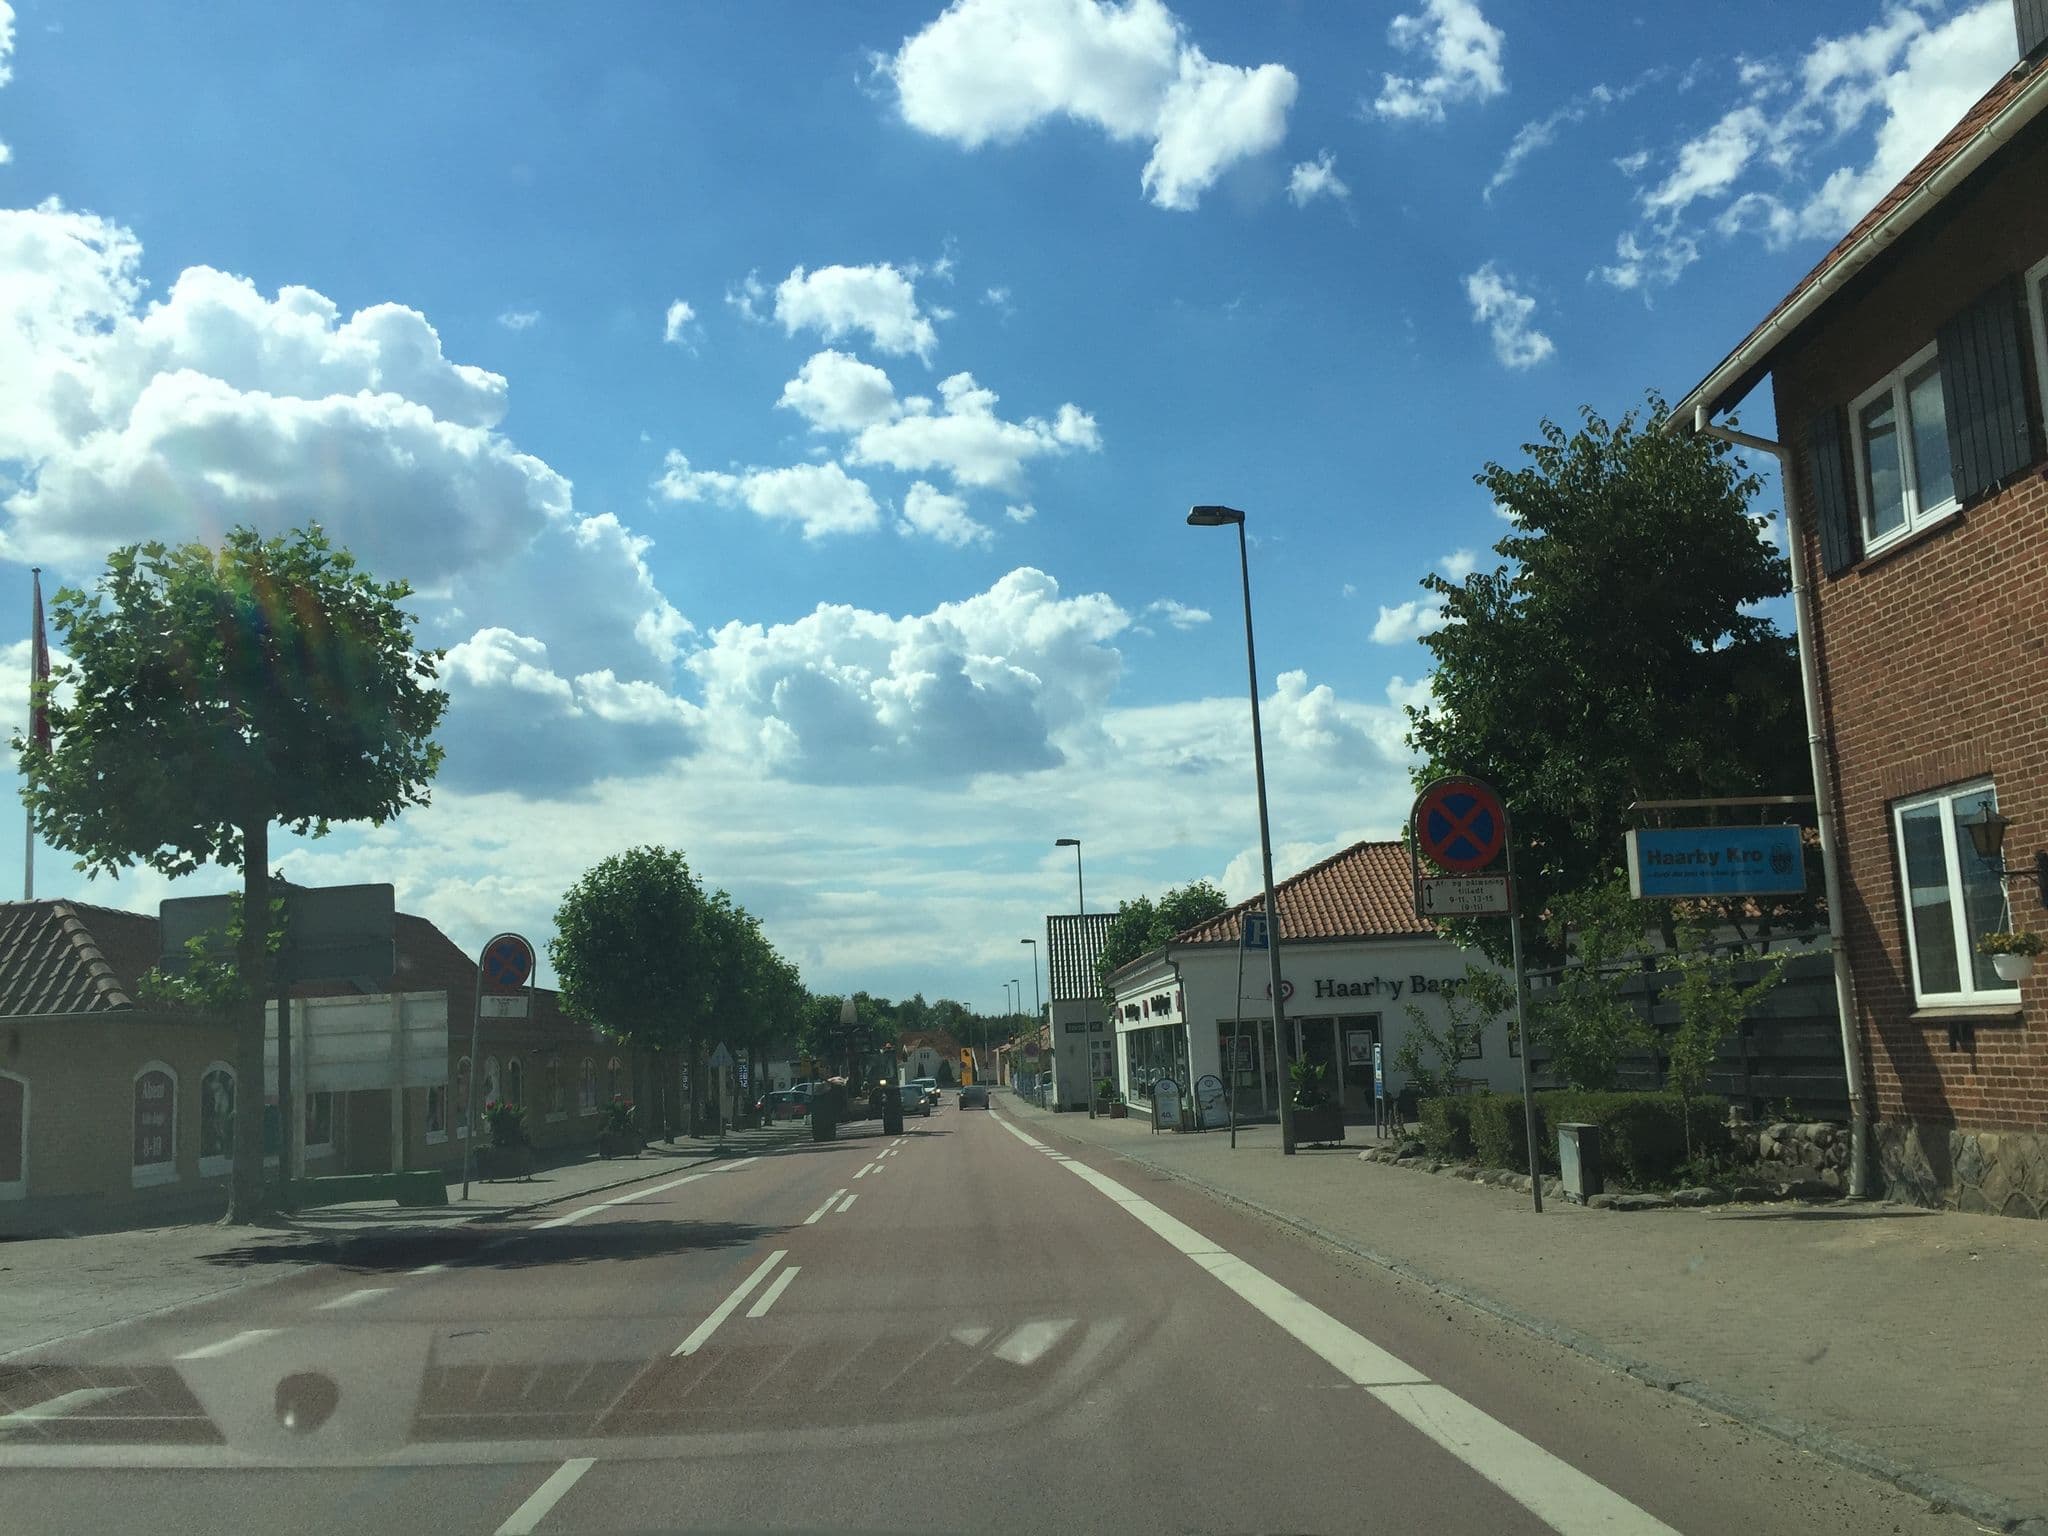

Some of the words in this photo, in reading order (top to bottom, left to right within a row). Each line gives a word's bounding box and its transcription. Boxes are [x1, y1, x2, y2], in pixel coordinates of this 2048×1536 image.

[1647, 848, 1720, 866] Haarby
[1727, 847, 1763, 863] Kro
[1314, 976, 1403, 1001] Haarby
